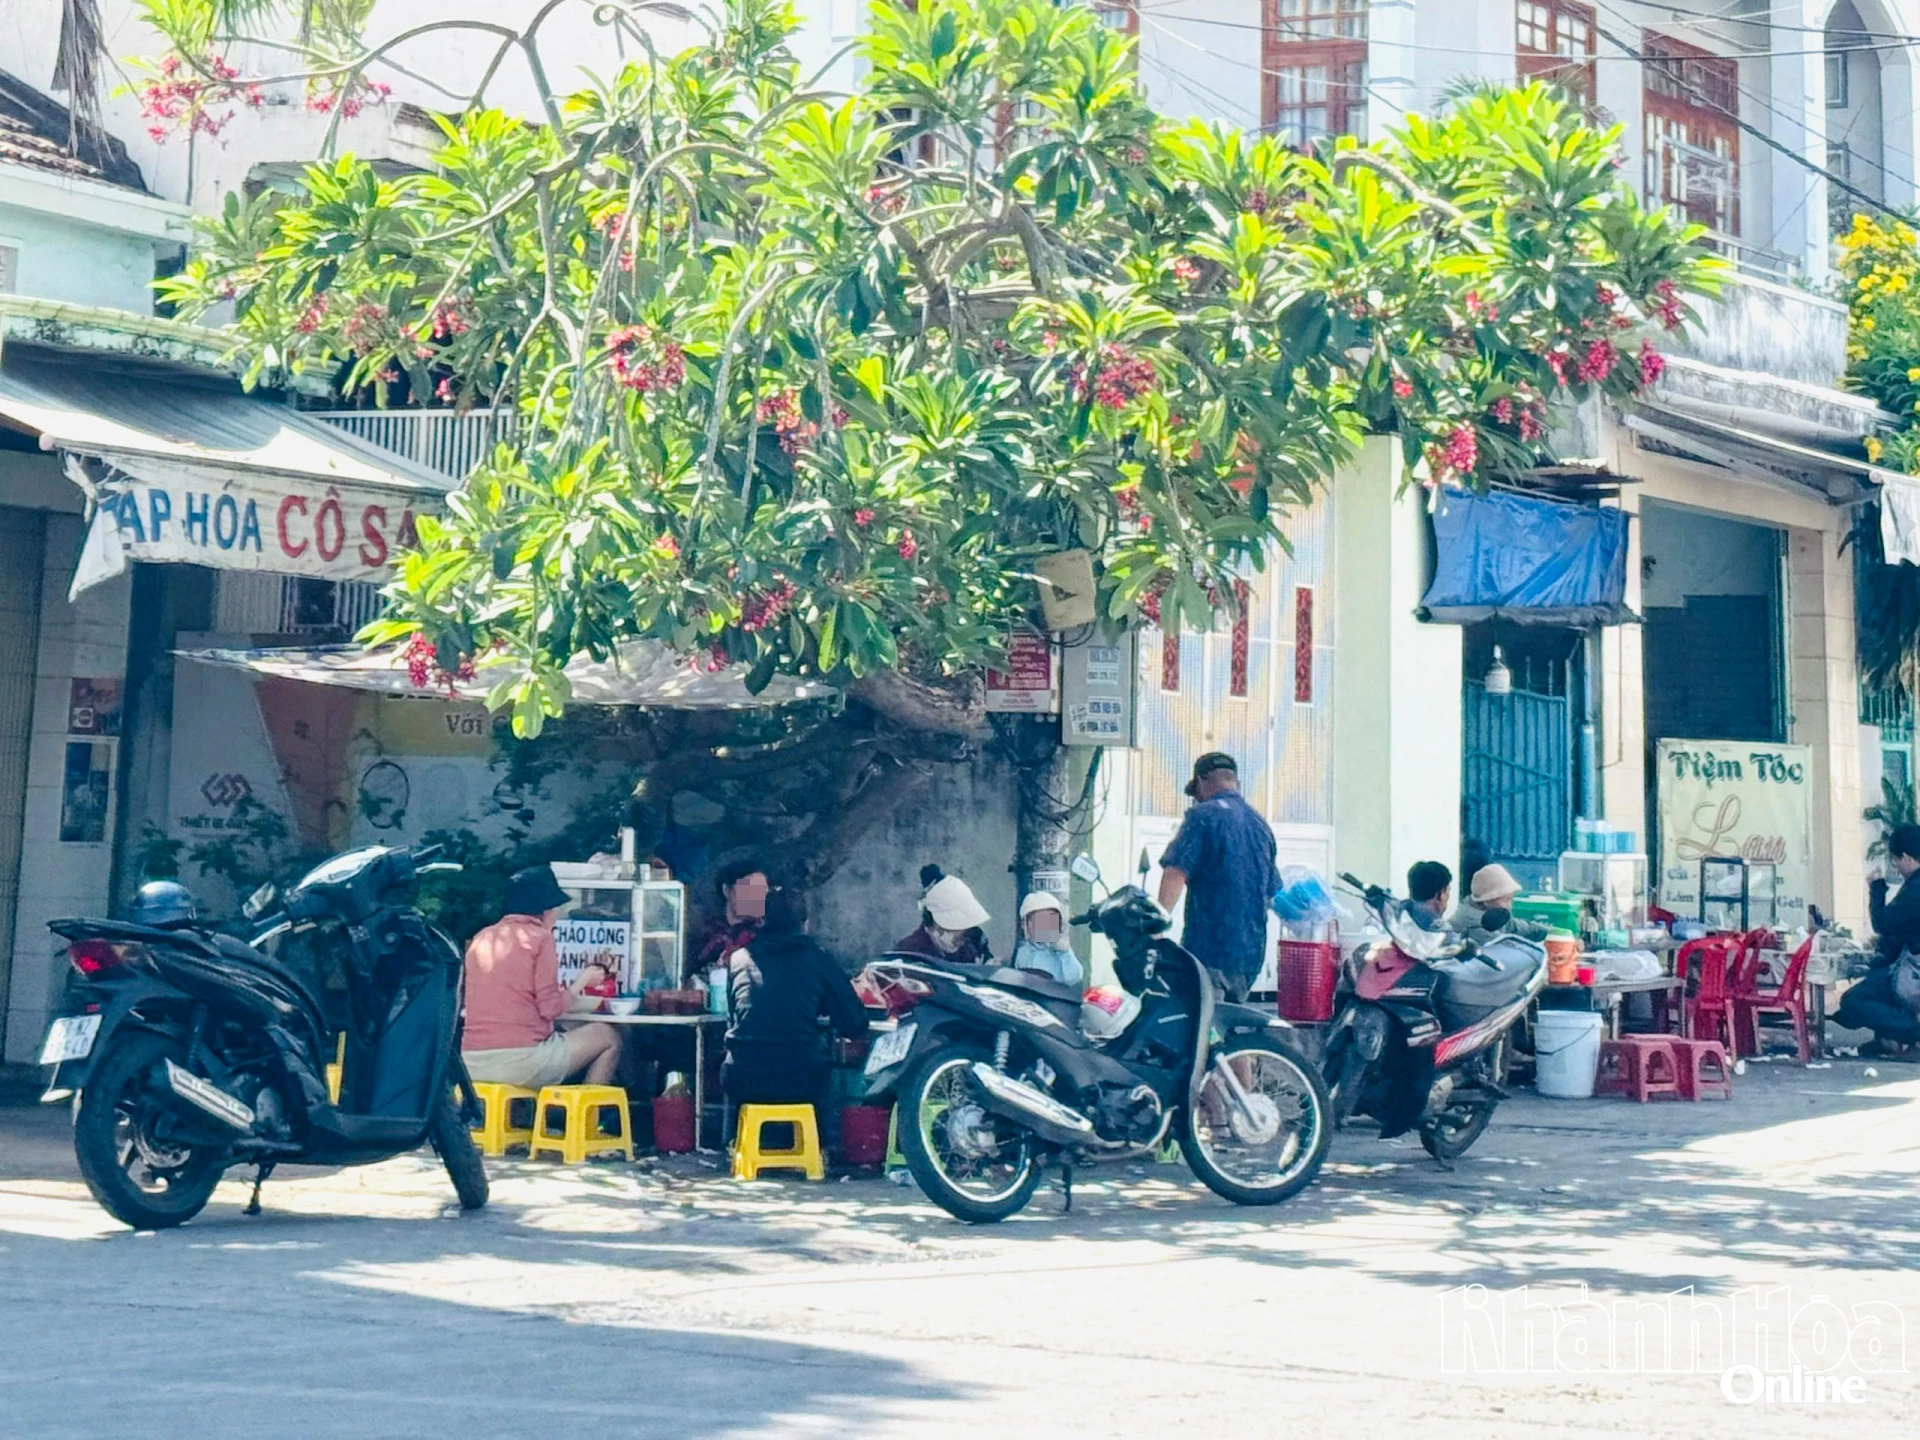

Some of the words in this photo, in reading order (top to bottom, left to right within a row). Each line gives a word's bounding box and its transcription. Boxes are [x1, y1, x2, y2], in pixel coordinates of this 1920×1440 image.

[185, 480, 262, 553] HÓA
[276, 486, 346, 562] CÔ
[445, 713, 483, 736] Với
[1668, 751, 1744, 790] Tiệm
[589, 921, 625, 945] LÒNG
